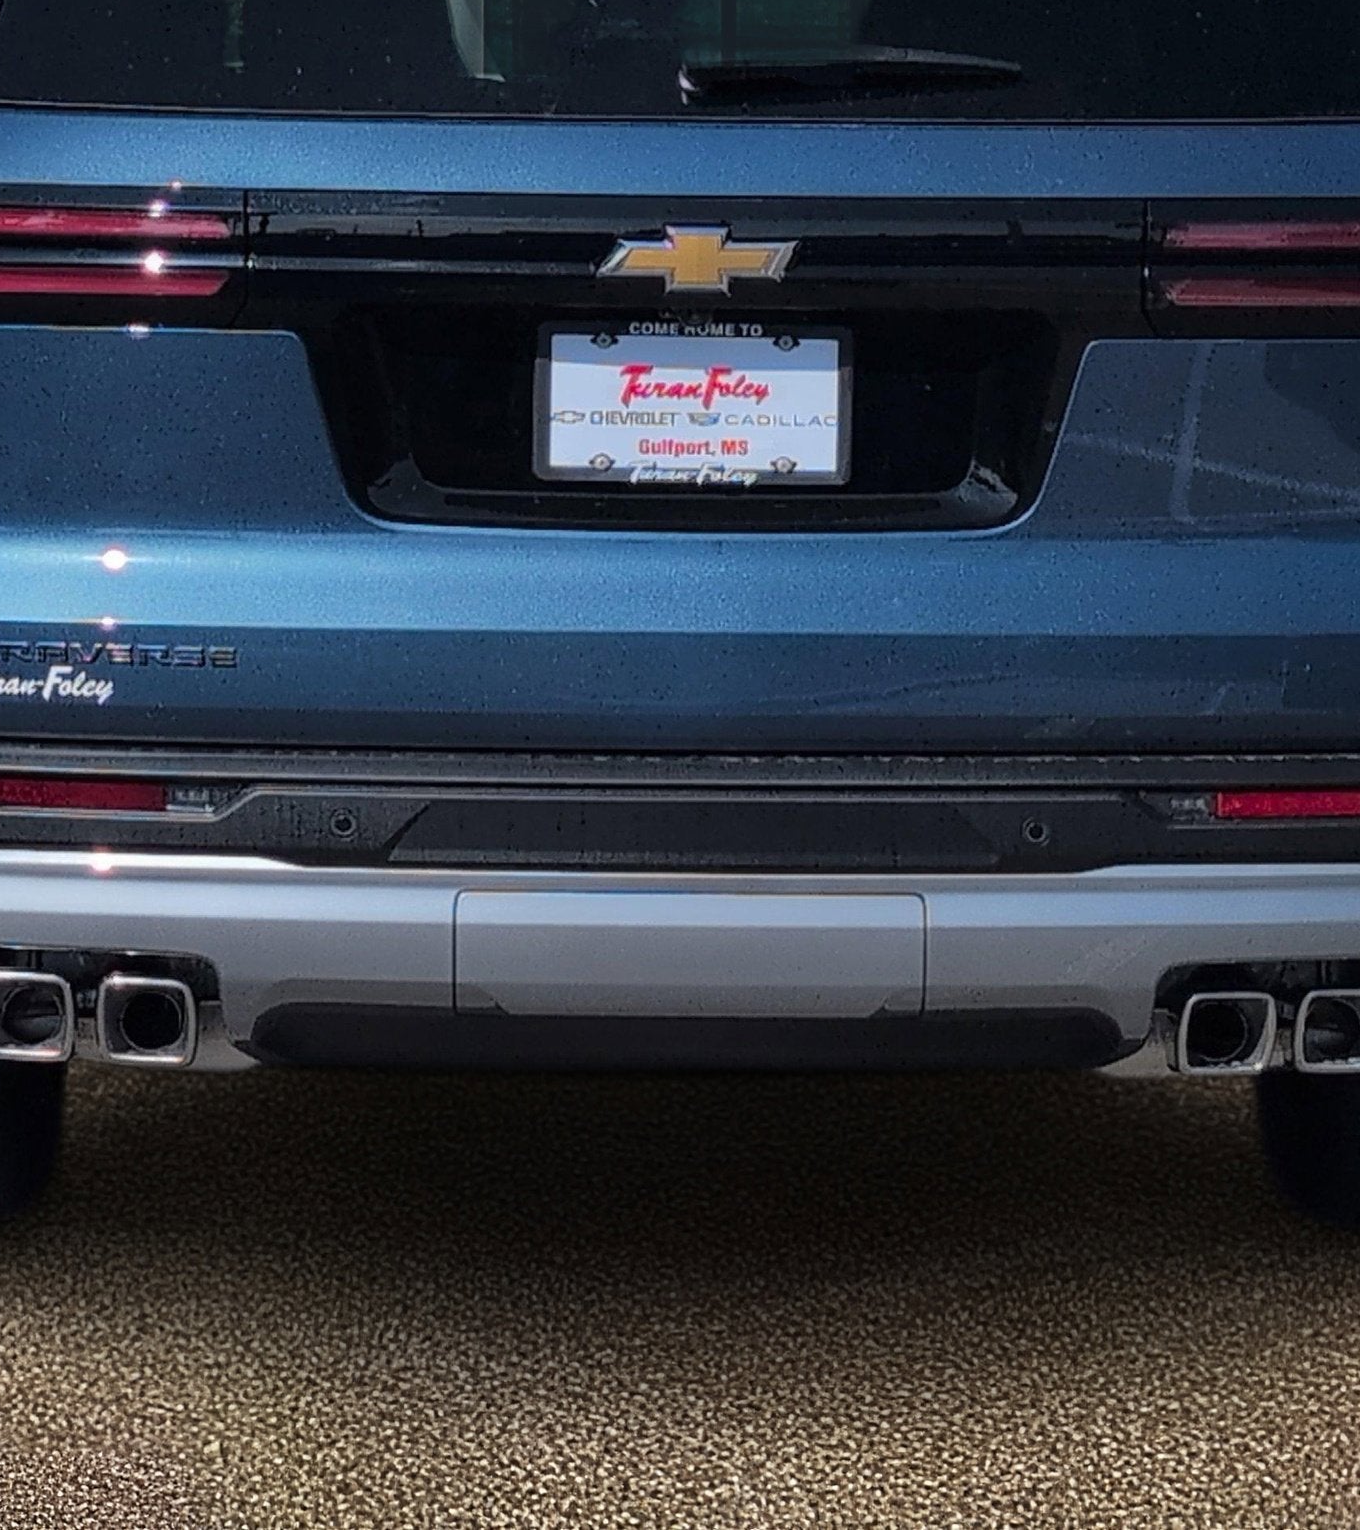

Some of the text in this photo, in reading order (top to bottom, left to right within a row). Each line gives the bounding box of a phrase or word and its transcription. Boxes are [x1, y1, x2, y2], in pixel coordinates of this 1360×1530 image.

[629, 321, 679, 336] COME
[739, 323, 764, 337] TO
[590, 411, 838, 428] CHEVROLET CADILLAC
[638, 438, 749, 458] Gulfport, MS
